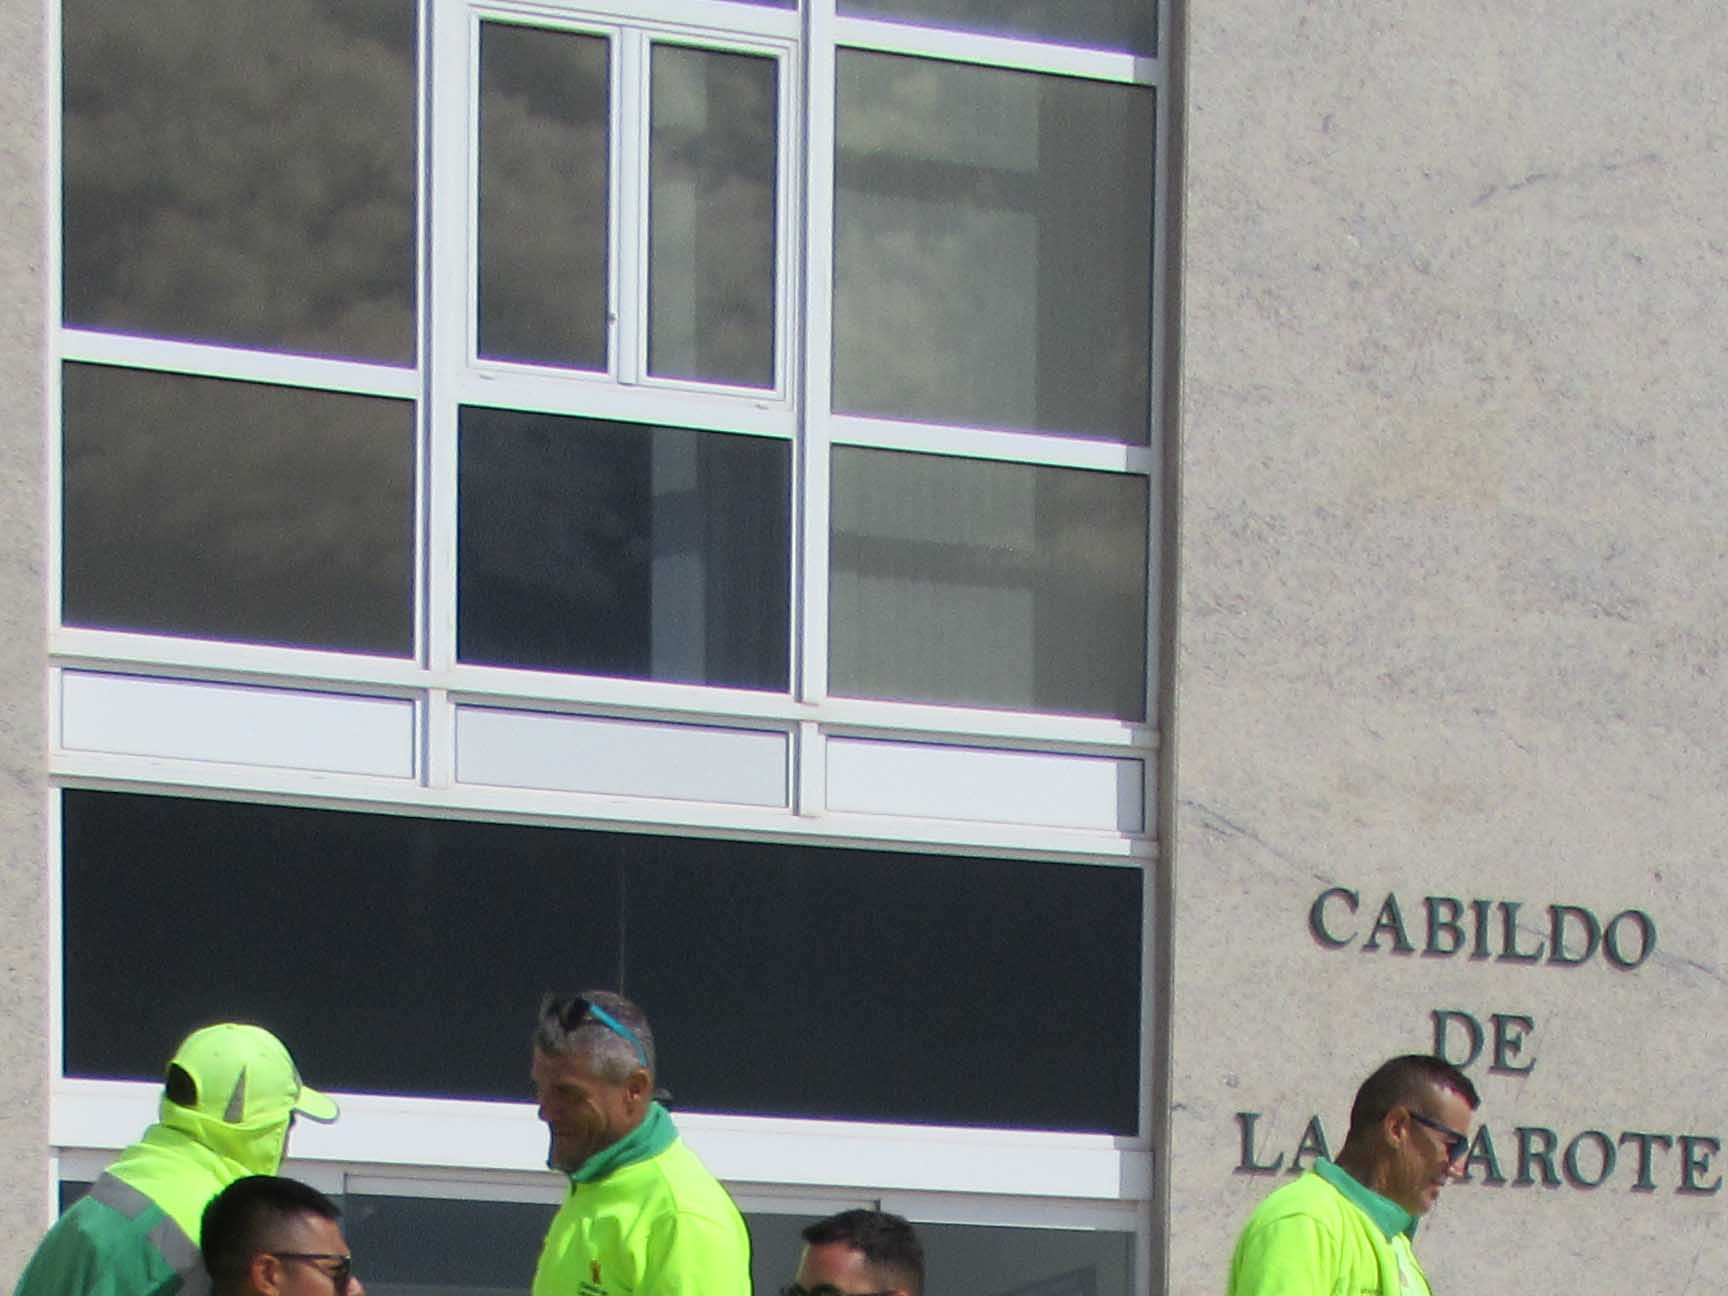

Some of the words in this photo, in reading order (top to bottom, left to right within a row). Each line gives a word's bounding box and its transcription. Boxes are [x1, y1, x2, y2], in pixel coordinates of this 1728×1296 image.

[1308, 886, 1657, 972] CABILDO
[1431, 1008, 1537, 1075] DE
[1233, 1111, 1724, 1195] LAAROTE
